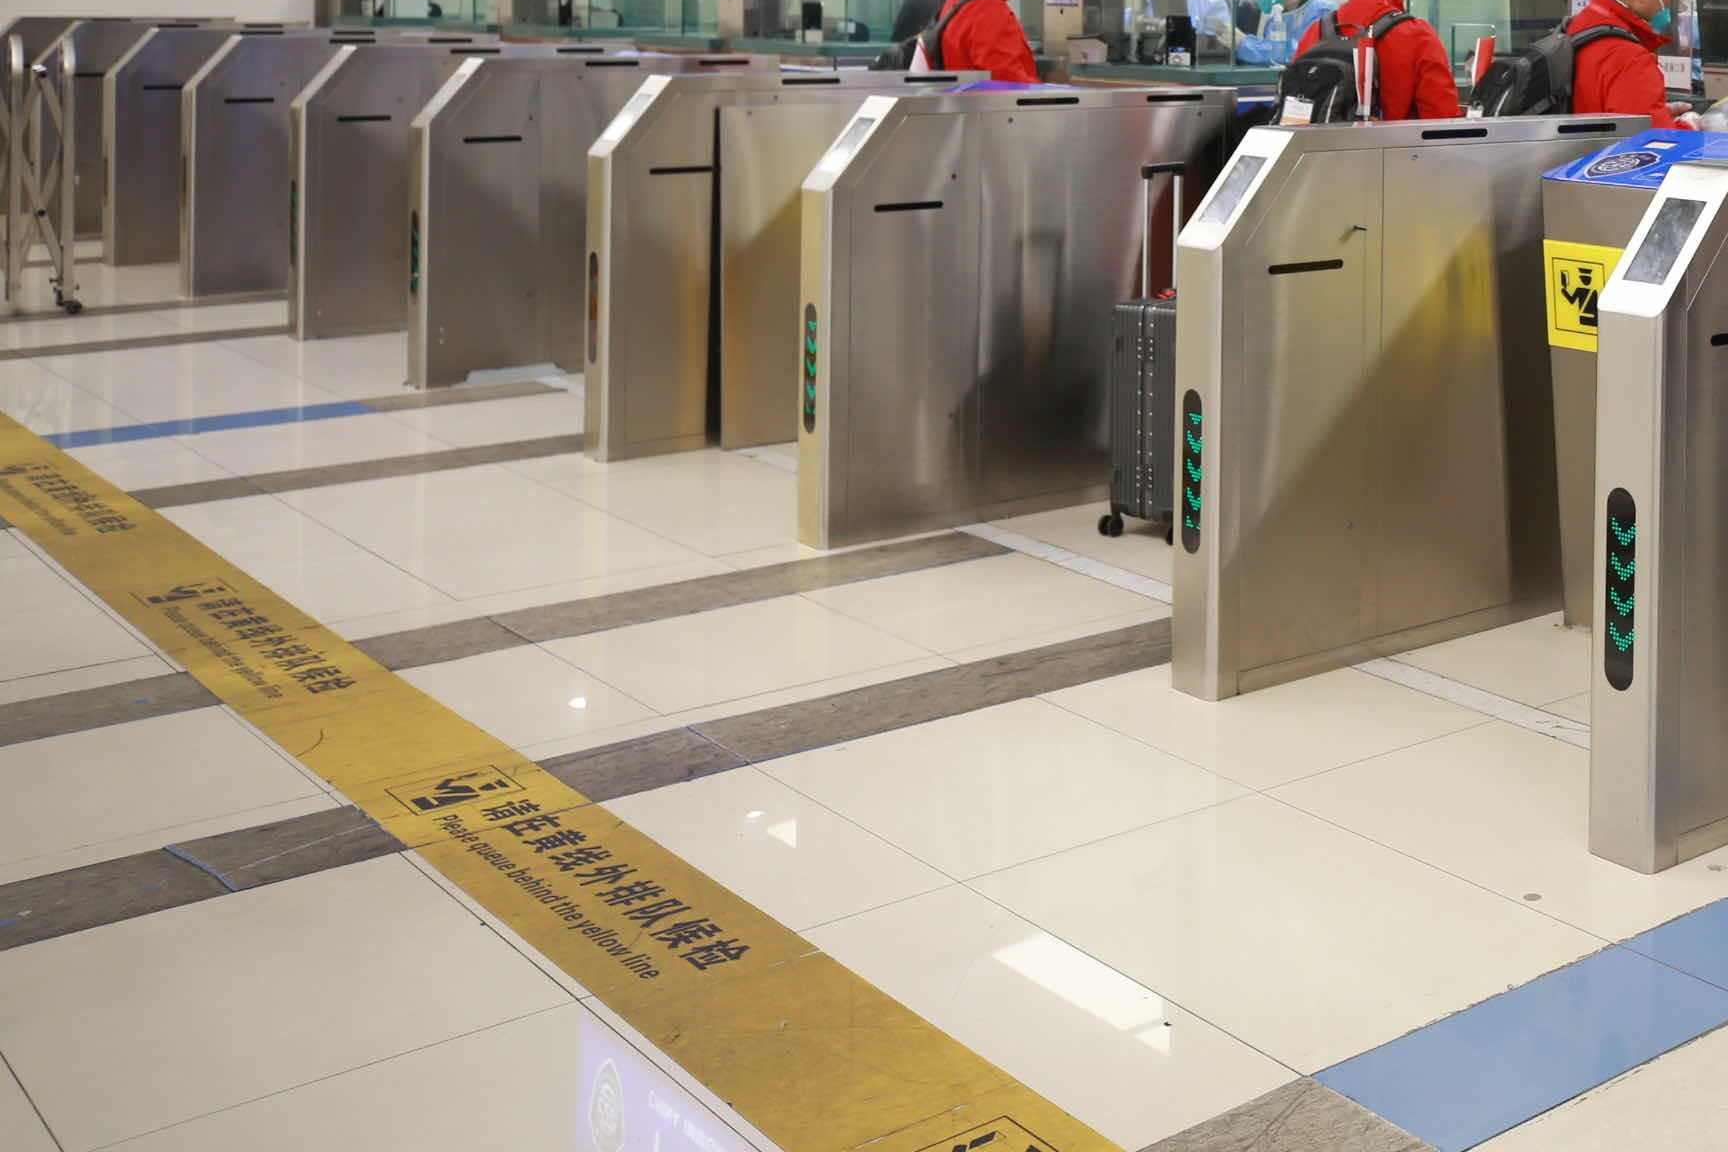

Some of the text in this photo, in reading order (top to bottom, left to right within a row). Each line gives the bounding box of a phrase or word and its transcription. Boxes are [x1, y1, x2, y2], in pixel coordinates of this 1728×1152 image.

[434, 813, 661, 981] Please queue behind the yellow line
[480, 798, 751, 971] 请在黄线外排队候检
